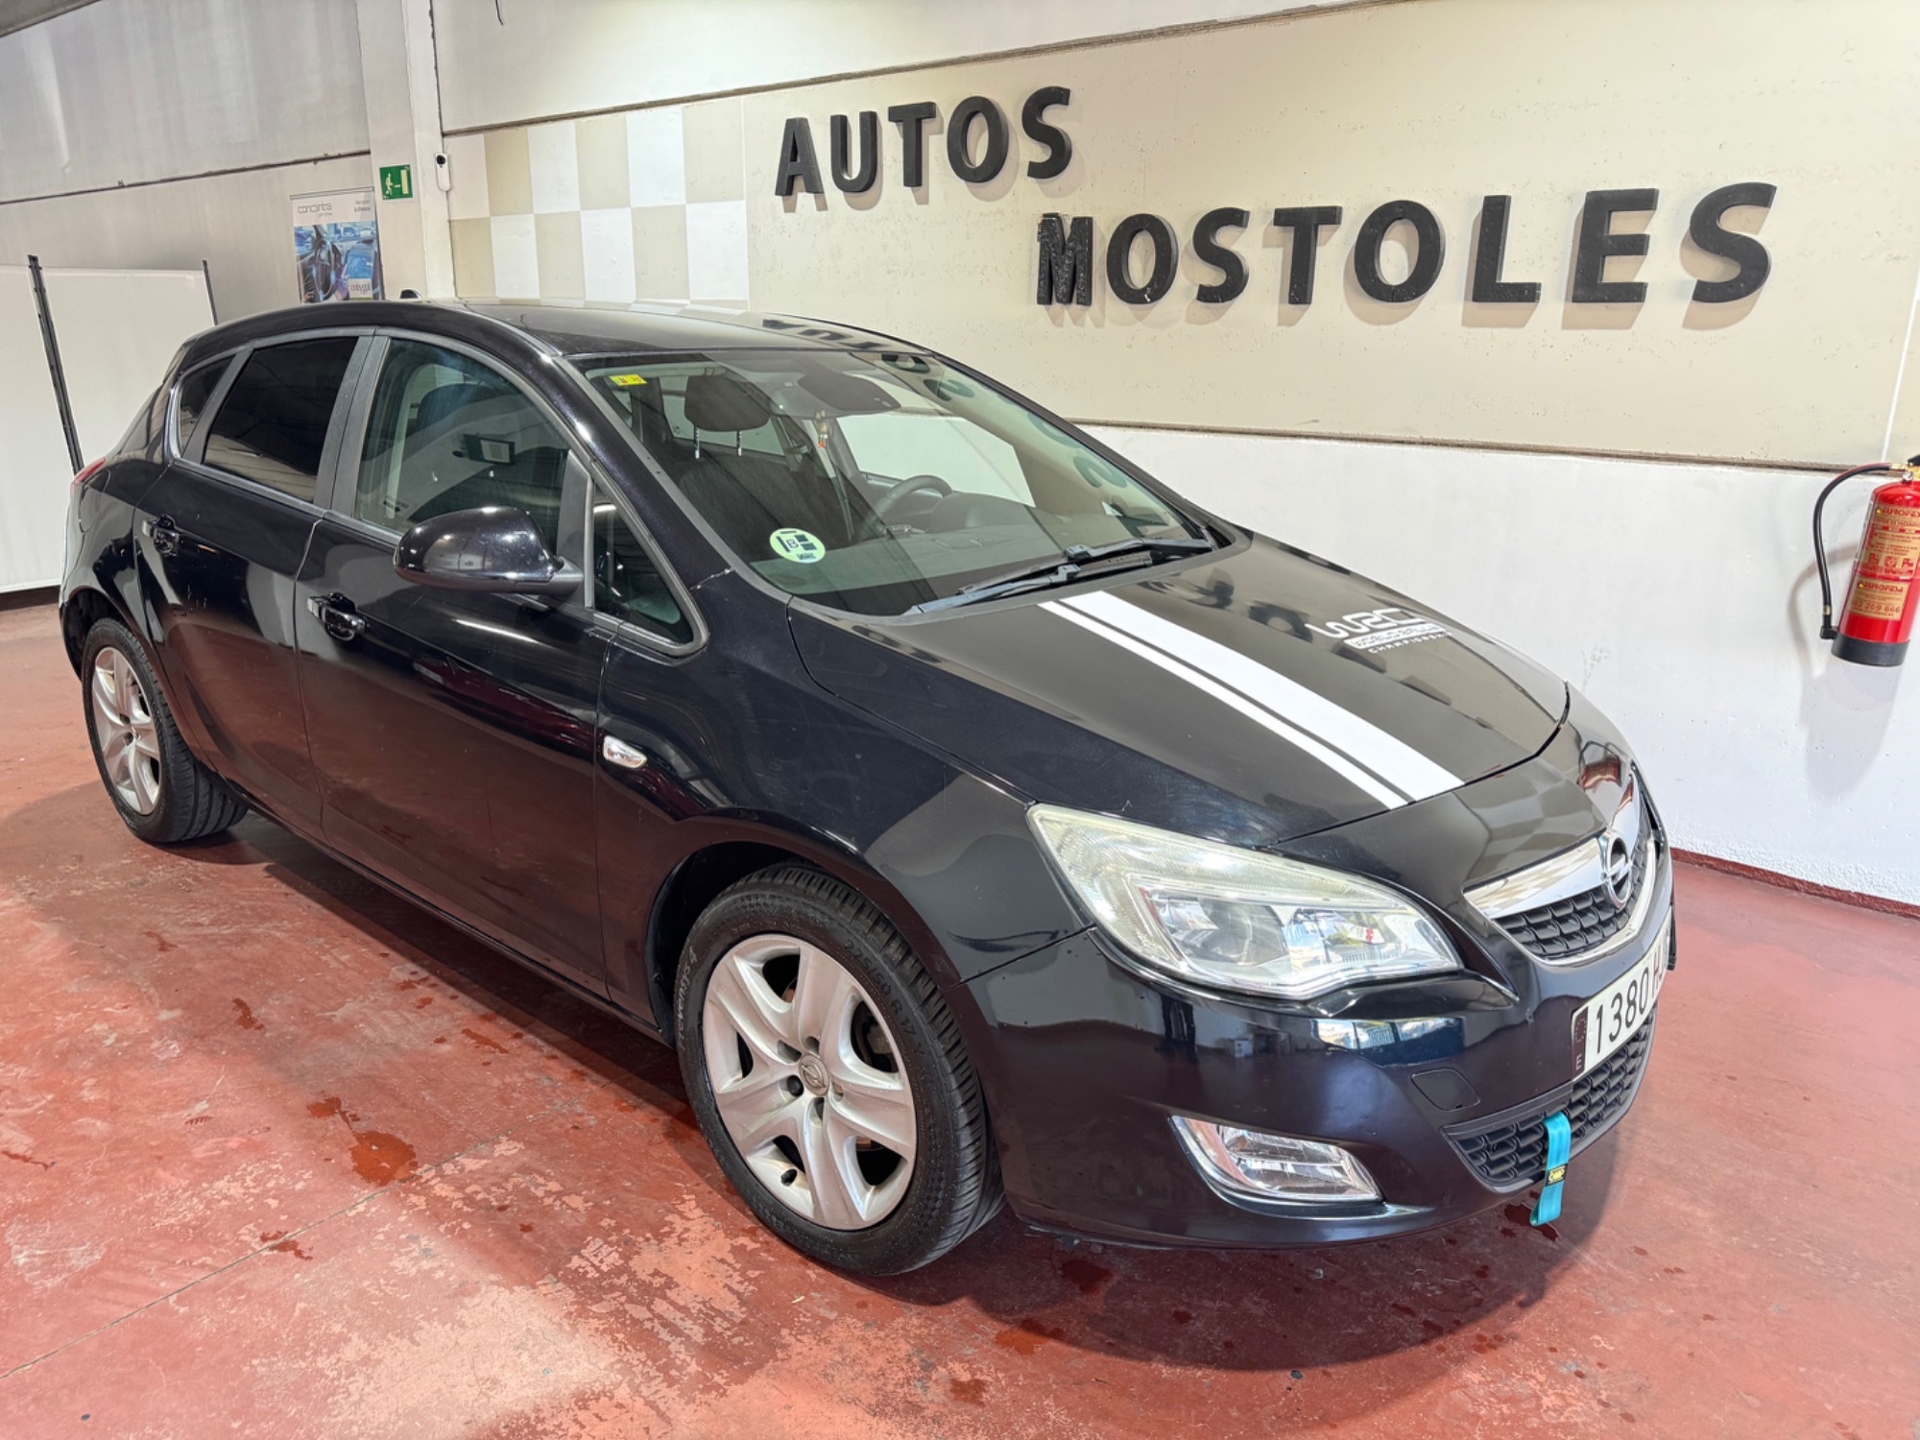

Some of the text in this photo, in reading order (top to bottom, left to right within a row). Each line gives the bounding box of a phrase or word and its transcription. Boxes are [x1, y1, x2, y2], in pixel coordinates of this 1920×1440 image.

[775, 86, 1070, 196] AUTOS
[1036, 182, 1776, 307] MOSTOLES
[1304, 607, 1426, 639] WRC
[1595, 966, 1649, 1055] 1380
[1575, 1053, 1583, 1071] E
